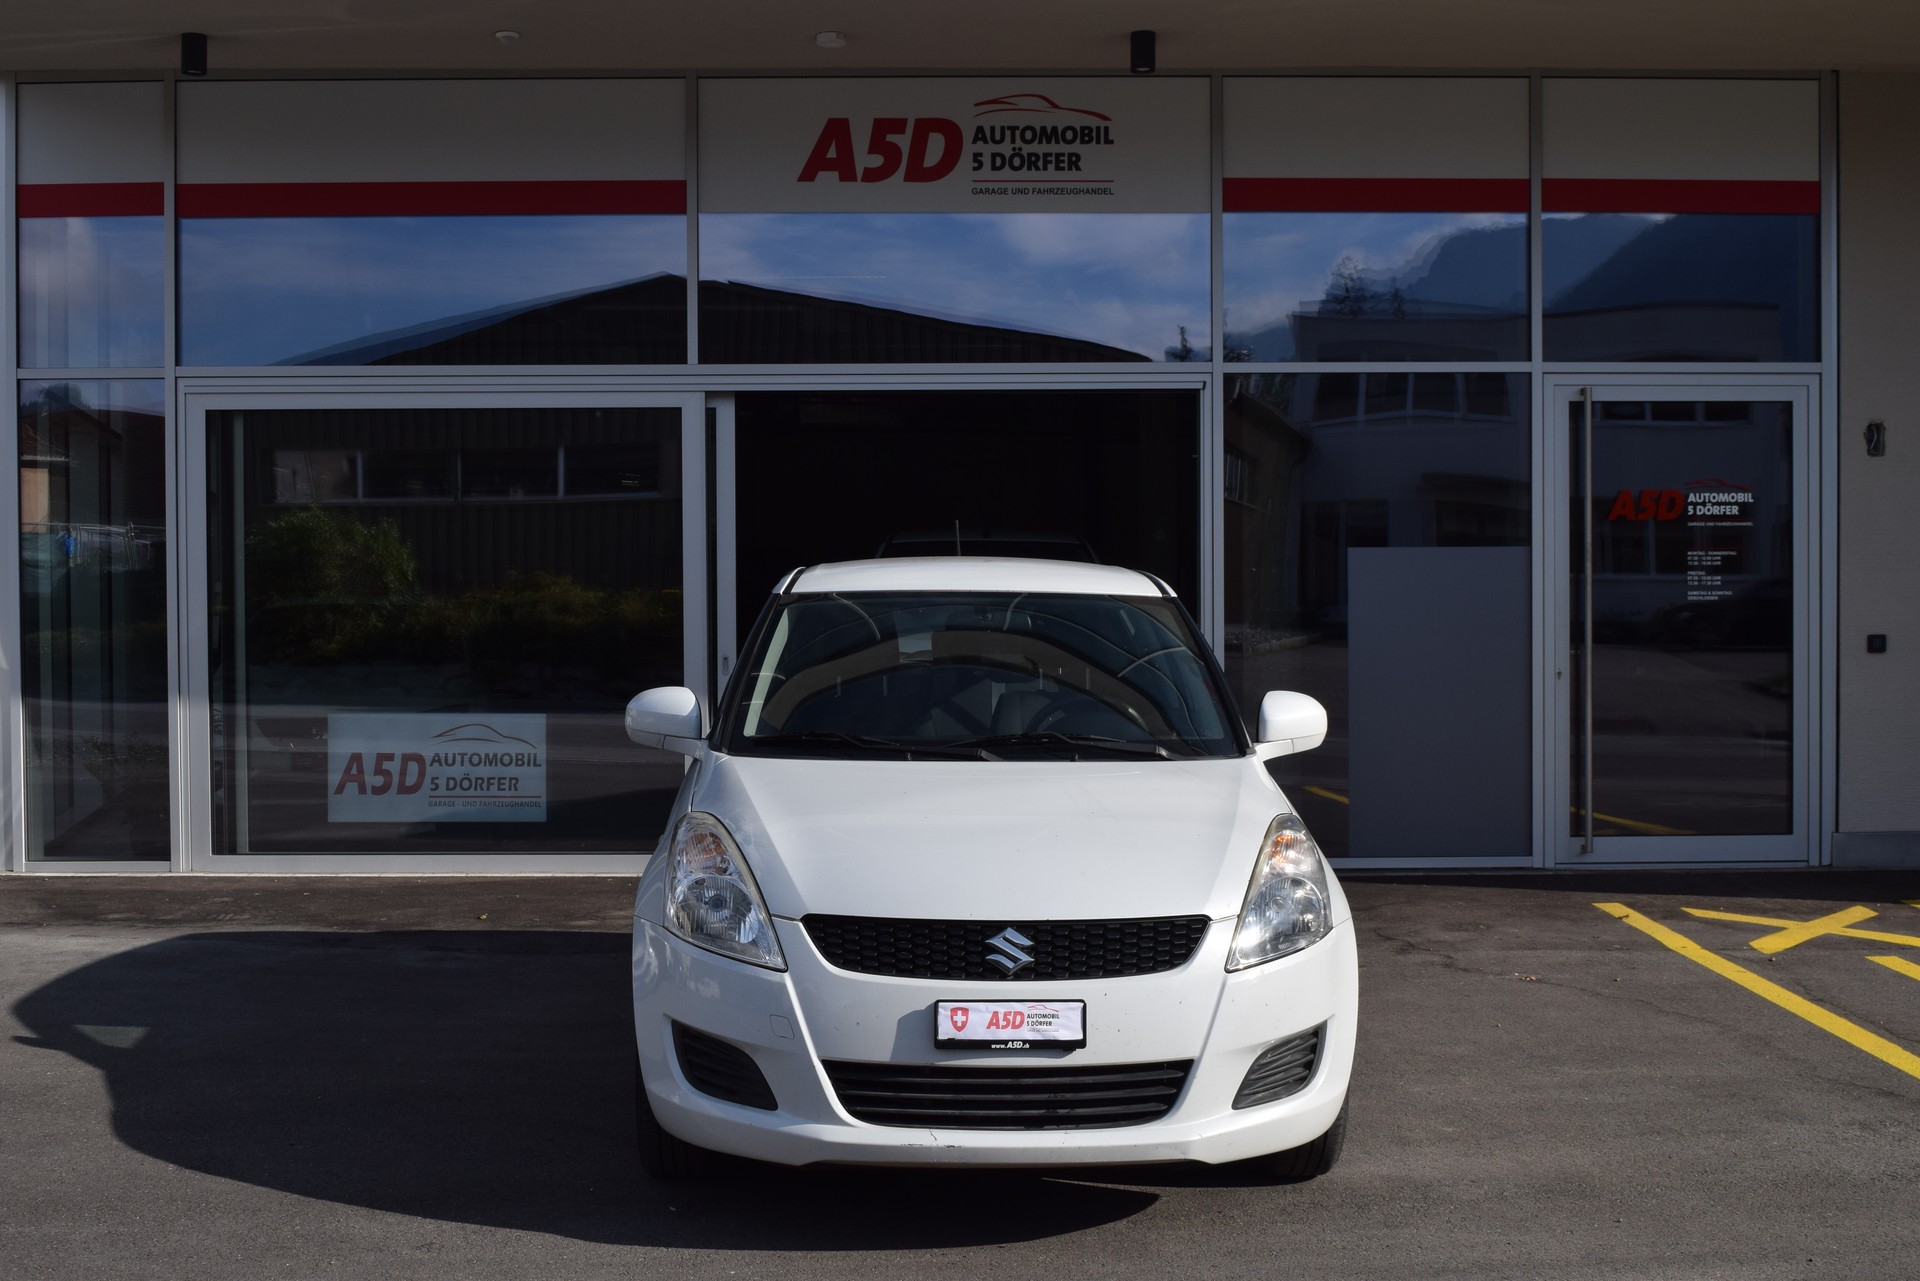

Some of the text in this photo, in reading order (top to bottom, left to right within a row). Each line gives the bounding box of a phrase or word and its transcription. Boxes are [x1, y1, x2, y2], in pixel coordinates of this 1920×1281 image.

[971, 125, 1115, 145] AUTOMOBIL
[797, 117, 964, 183] A5D
[972, 146, 1082, 172] 5 DÖRFER
[971, 187, 1114, 196] GARAGE UND FAHRZEUGHANDEL
[1607, 489, 1686, 521] A5D
[1687, 492, 1754, 503] AUTOMOBIL
[1687, 503, 1739, 515] 5 DÖRFER
[429, 752, 542, 768] AUTOMOBIL
[333, 752, 427, 796] A5D
[430, 773, 519, 792] 5 DÖRFER
[428, 800, 456, 808] GARAGE
[461, 800, 477, 808] UND
[478, 800, 542, 808] FAHRZEUGHANDEL
[986, 1010, 1025, 1030] A5D
[1030, 1019, 1053, 1027] DÖRFER
[991, 1041, 1030, 1049] www.A5D.ch
